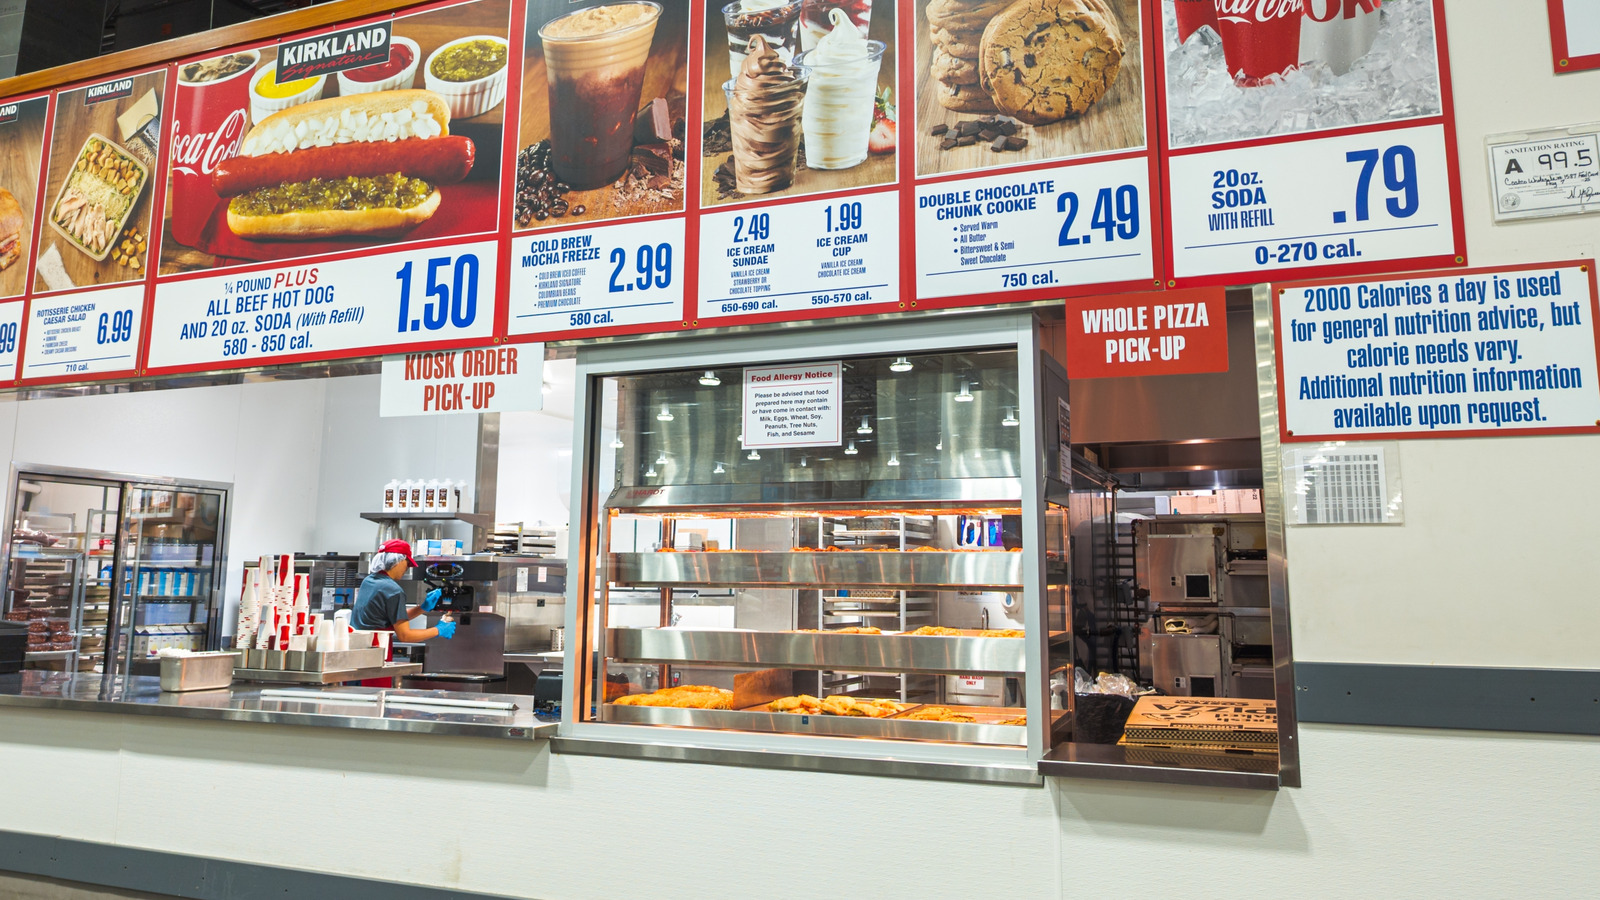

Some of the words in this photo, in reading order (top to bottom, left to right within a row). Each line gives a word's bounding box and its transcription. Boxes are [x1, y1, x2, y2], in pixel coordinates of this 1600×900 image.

[283, 28, 386, 66] KIRKLAND
[281, 52, 385, 82] Signature
[88, 80, 132, 97] KIRKLAND
[1504, 144, 1552, 154] SANITATION
[1554, 141, 1585, 149] RATING
[1505, 159, 1523, 174] A
[1538, 149, 1592, 170] 99.5
[919, 190, 970, 208] DOUBLE
[975, 180, 1054, 202] CHOCOLATE
[1333, 145, 1419, 224] .79
[936, 205, 982, 220] CHUNK
[987, 197, 1036, 215] COOKIE
[1211, 187, 1267, 209] SODA
[824, 202, 862, 233] 1.99
[1057, 184, 1140, 247] 2.49
[1208, 212, 1238, 232] WITH
[1241, 208, 1275, 228] REFILL
[734, 212, 769, 243] 2.49
[960, 222, 979, 232] Served
[981, 222, 998, 230] Warm
[531, 238, 558, 253] COLD
[561, 235, 592, 249] BREW
[817, 237, 831, 248] ICE
[834, 234, 868, 246] CREAM
[961, 243, 992, 254] Bittersweet
[994, 242, 998, 251] &
[1001, 240, 1014, 250] Semi
[969, 234, 986, 242] Butter
[522, 253, 559, 268] MOCHA
[562, 247, 600, 263] FREEZE
[727, 248, 740, 257] ICE
[743, 244, 775, 256] CREAM
[832, 246, 851, 257] CUP
[961, 256, 978, 266] Sweet
[980, 254, 1006, 264] Chocolate
[1255, 242, 1317, 265] 0-270
[1322, 238, 1362, 259] cal.
[609, 242, 672, 293] 2.99
[732, 256, 768, 267] SUNDAE
[821, 261, 839, 269] VANILLA
[848, 258, 863, 266] CREAM
[274, 268, 319, 289] PLUS
[539, 272, 549, 280] COLD
[550, 271, 561, 279] BREW
[572, 268, 586, 276] COFFEE
[734, 278, 760, 286] STRAWBERRY
[818, 269, 841, 278] CHOCOLATE
[851, 267, 866, 275] CREAM
[1002, 272, 1027, 288] 750
[1032, 270, 1059, 285] cal.
[236, 277, 271, 293] POUND
[396, 254, 479, 333] 1.50
[730, 286, 751, 294] CHOCOLATE
[1304, 286, 1351, 312] 2000
[1357, 282, 1432, 309] Calories
[1438, 284, 1448, 303] a
[1455, 278, 1486, 305] day
[1493, 275, 1510, 300] is
[1517, 271, 1561, 298] used
[206, 299, 231, 316] ALL
[236, 294, 268, 313] BEEF
[272, 290, 300, 309] HOT
[305, 285, 334, 305] DOG
[721, 301, 759, 313] 650-690
[762, 299, 778, 309] cal.
[811, 293, 852, 305] 550-570
[854, 291, 872, 301] cal.
[37, 306, 69, 318] ROTISSERIE
[70, 303, 96, 314] CHICKEN
[44, 315, 66, 325] CAESAR
[67, 313, 86, 322] SALAD
[570, 312, 590, 326] 580
[593, 311, 614, 324] cal.
[1082, 306, 1148, 334] WHOLE
[1154, 302, 1209, 329] PIZZA
[97, 309, 133, 345] 6.99
[180, 321, 207, 340] AND
[212, 319, 227, 337] 20
[232, 320, 249, 334] oz.
[255, 312, 291, 332] SODA
[296, 312, 325, 331] (With
[329, 306, 365, 324] Refill)
[1291, 319, 1316, 342] for
[1323, 313, 1388, 344] general
[1395, 309, 1471, 336] nutrition
[1478, 304, 1544, 331] advice,
[1550, 302, 1581, 326] but
[223, 338, 247, 356] 580
[261, 334, 285, 353] 850
[290, 331, 313, 350] cal.
[1106, 335, 1186, 363] PICK-UP
[1347, 342, 1409, 368] calorie
[1416, 338, 1468, 364] needs
[1474, 339, 1522, 364] vary.
[66, 364, 76, 372] 710
[78, 363, 89, 371] cal.
[404, 352, 456, 381] KIOSK
[462, 348, 518, 378] ORDER
[774, 373, 802, 381] Allergy
[1300, 373, 1383, 400] Additional
[1390, 370, 1466, 396] nutrition
[1473, 364, 1582, 392] information
[423, 382, 495, 411] PICK-UP
[1334, 402, 1412, 428] available
[1418, 404, 1461, 429] upon
[1467, 398, 1547, 427] request.
